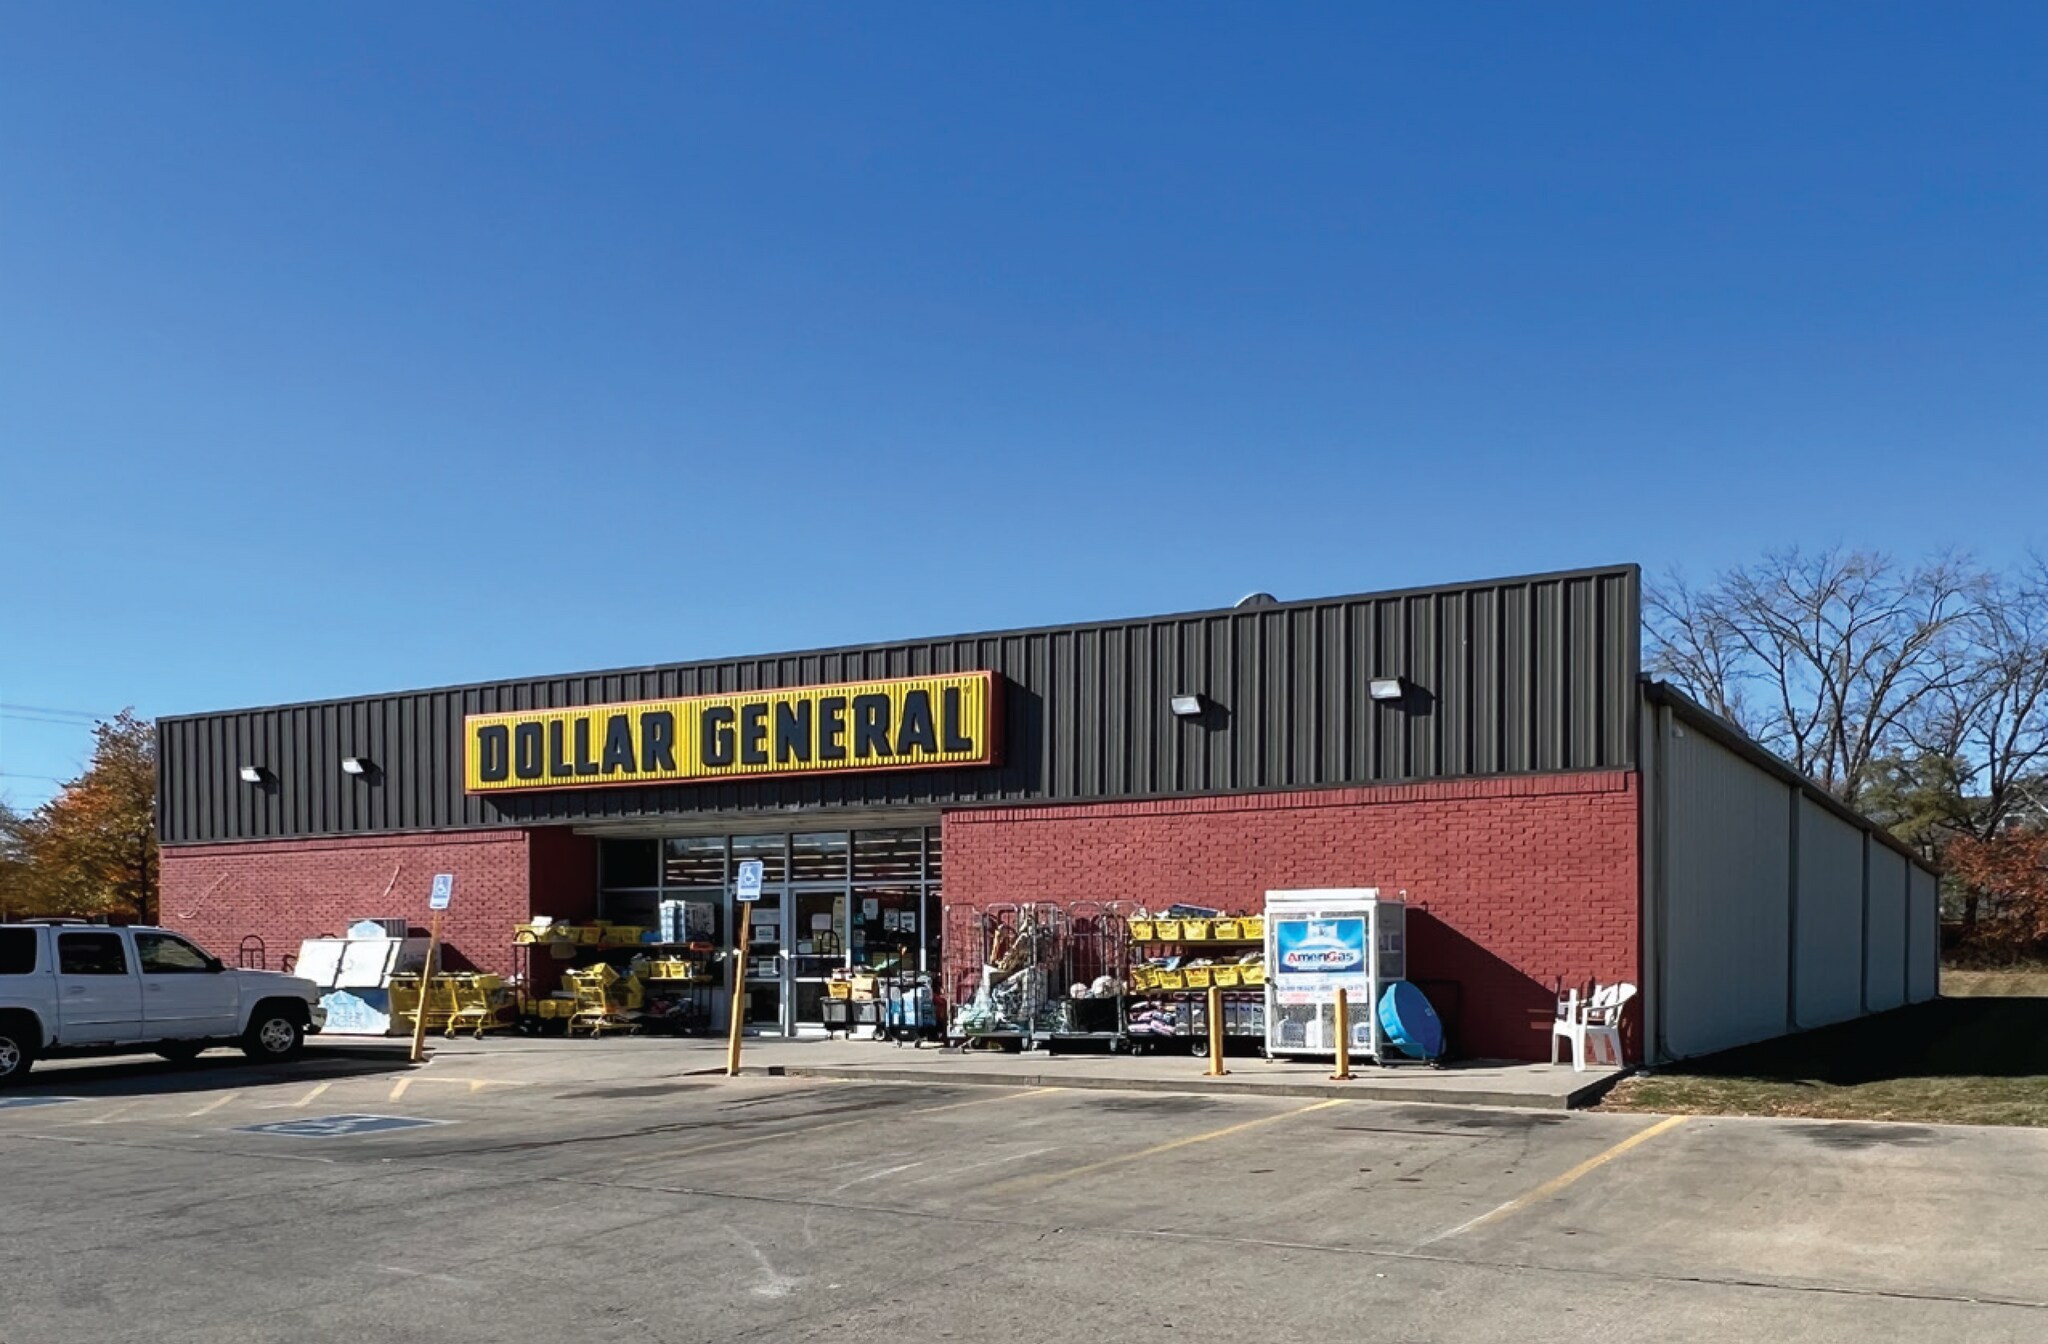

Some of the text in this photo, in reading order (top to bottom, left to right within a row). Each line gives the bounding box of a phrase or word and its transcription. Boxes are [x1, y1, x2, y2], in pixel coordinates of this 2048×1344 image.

[478, 687, 973, 781] DOLLAR GENERAL
[1288, 951, 1353, 962] AmeriGas
